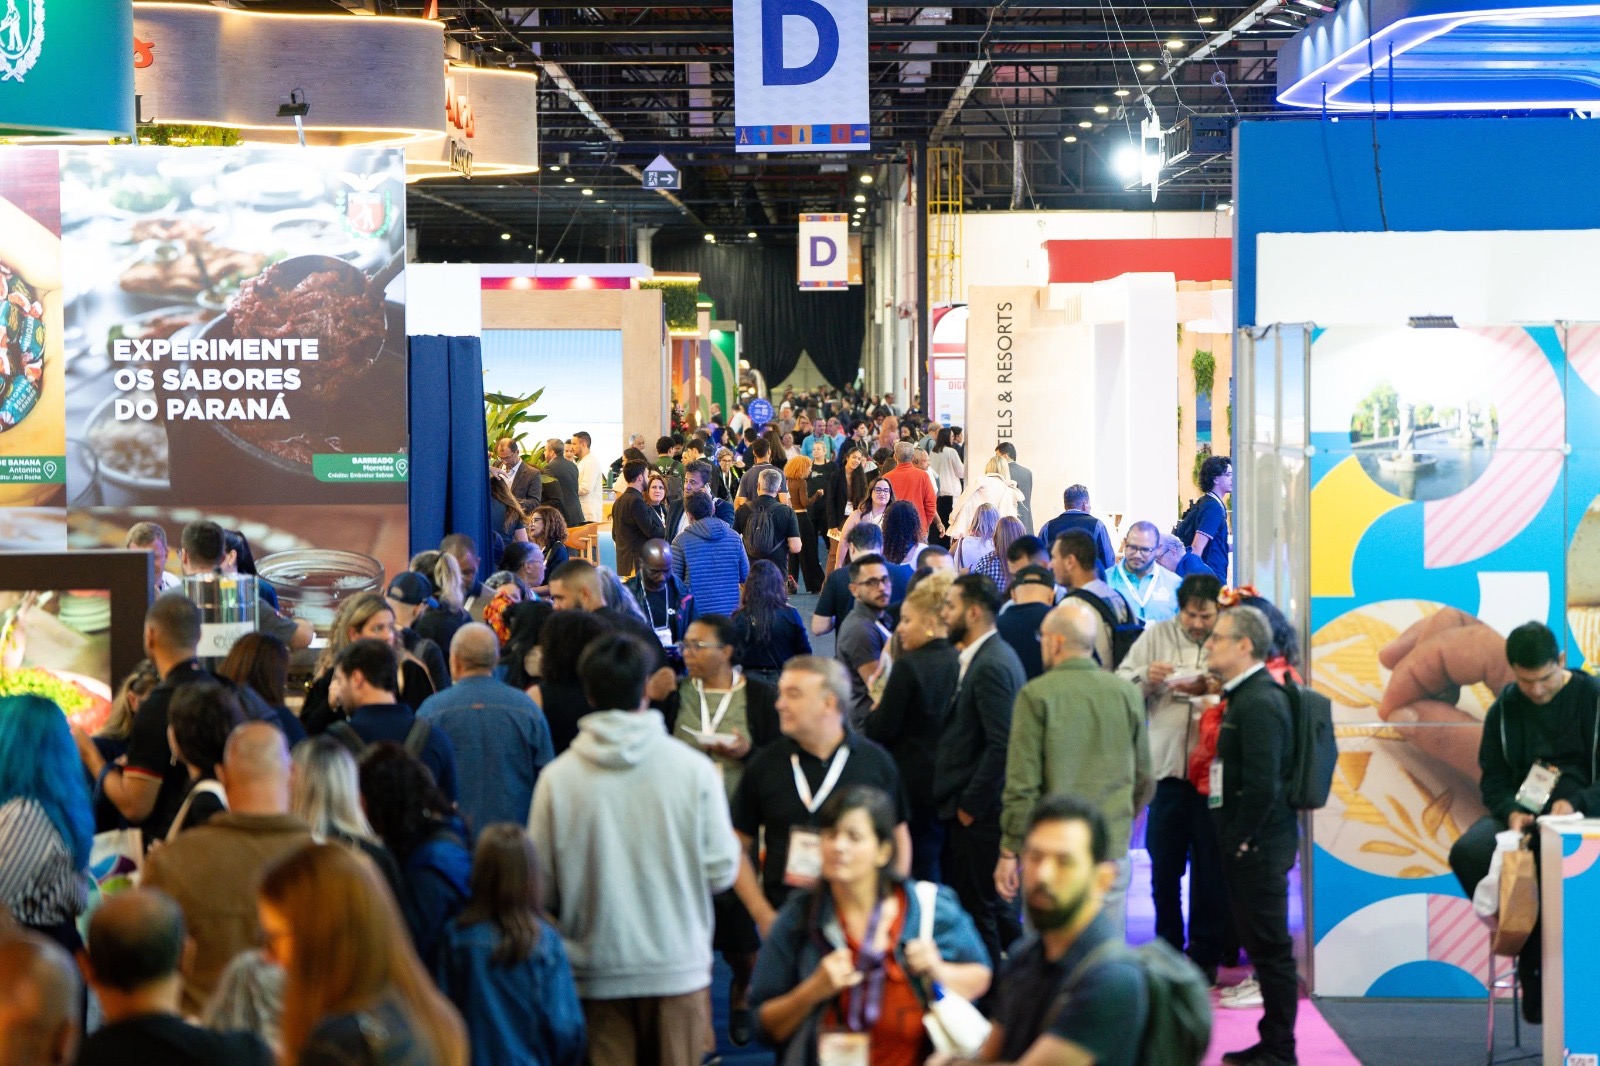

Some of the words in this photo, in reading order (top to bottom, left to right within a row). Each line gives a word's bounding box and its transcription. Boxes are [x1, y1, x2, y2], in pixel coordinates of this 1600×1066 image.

[761, 0, 840, 87] D
[809, 235, 837, 267] D
[113, 339, 319, 362] EXPERIMENTE
[997, 302, 1012, 383] RESORTS
[113, 368, 155, 391] OS
[162, 368, 302, 391] SABORES
[114, 398, 159, 421] DO
[166, 392, 291, 421] PARANÁ
[997, 390, 1012, 403] &
[9, 466, 41, 474] Antonina
[362, 464, 394, 472] Morretes
